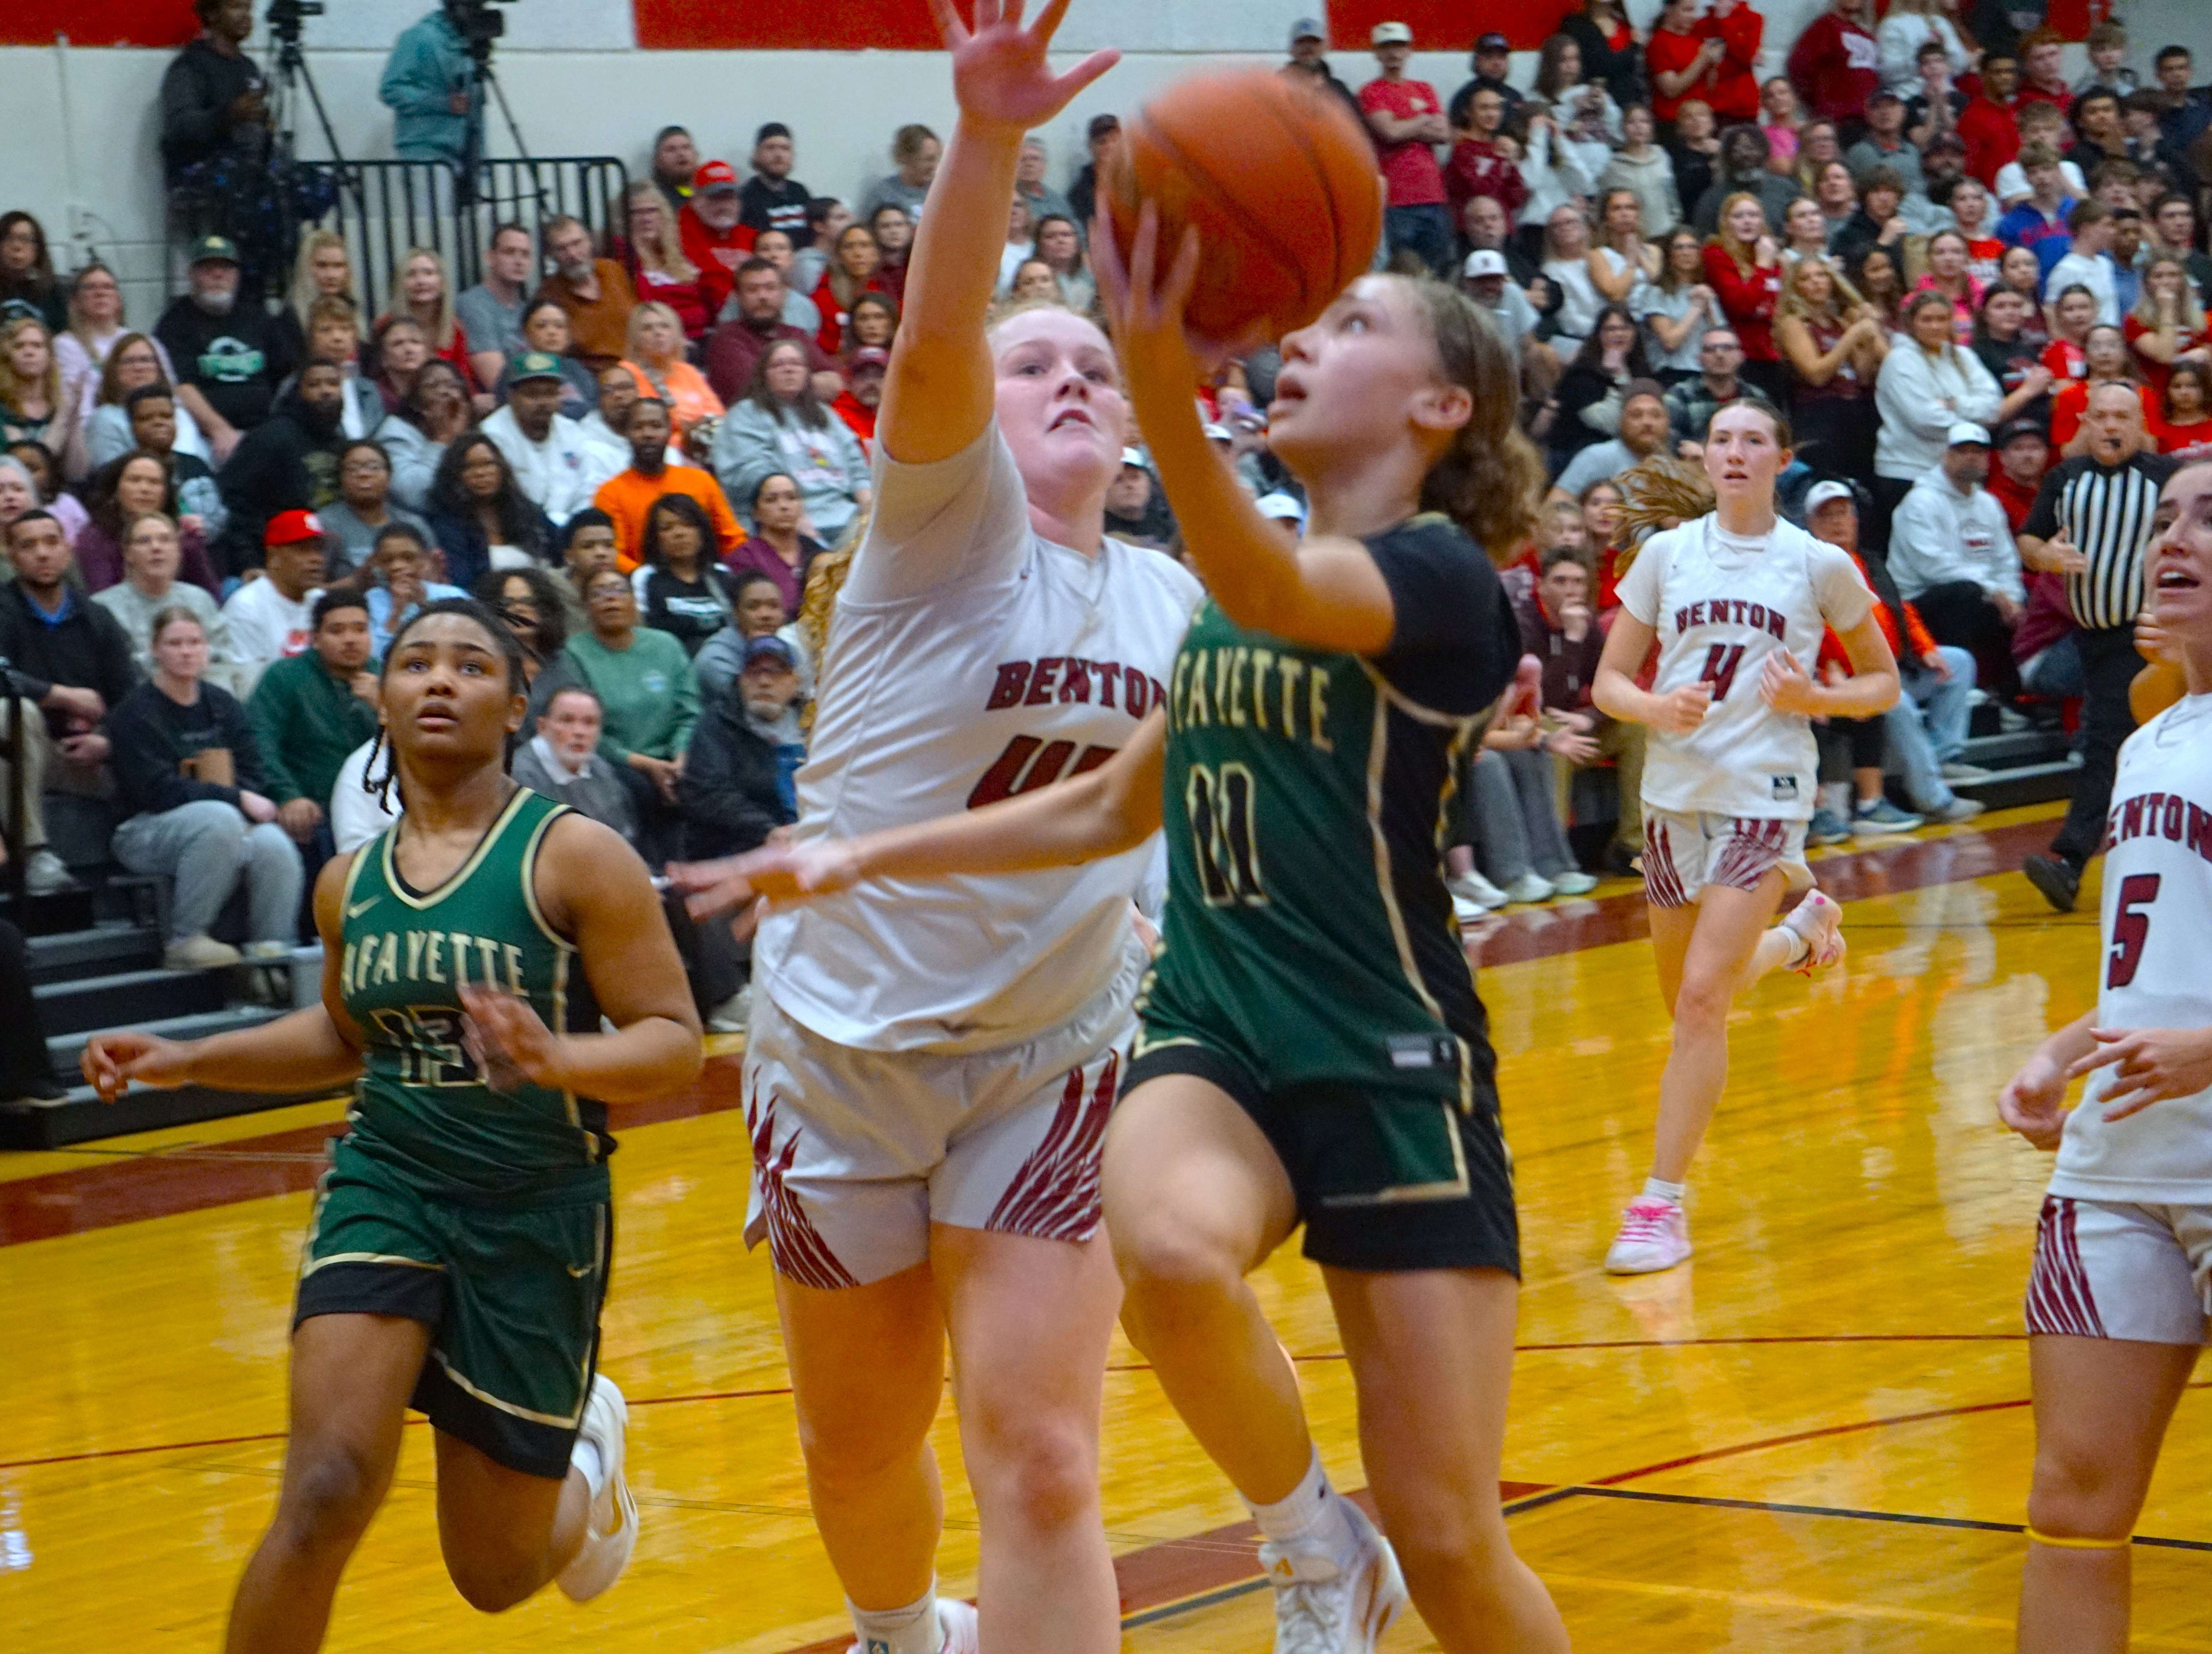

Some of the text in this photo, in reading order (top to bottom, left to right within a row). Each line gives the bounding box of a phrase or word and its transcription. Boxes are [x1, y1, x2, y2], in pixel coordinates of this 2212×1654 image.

[1675, 598, 1786, 641] BENTON
[1700, 644, 1746, 700] 4
[2107, 873, 2161, 990] 5
